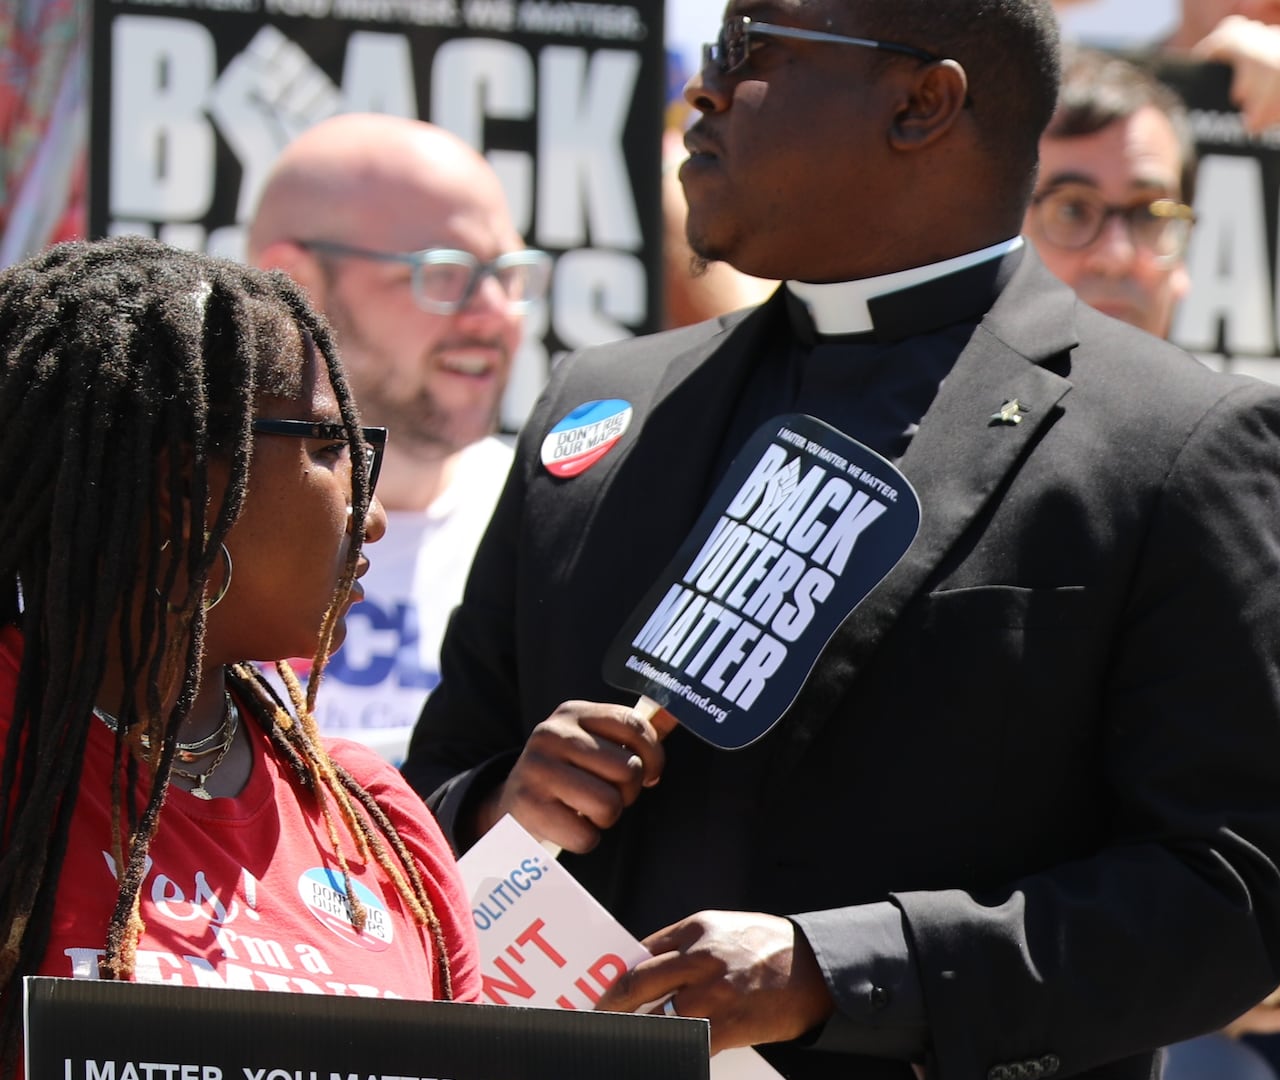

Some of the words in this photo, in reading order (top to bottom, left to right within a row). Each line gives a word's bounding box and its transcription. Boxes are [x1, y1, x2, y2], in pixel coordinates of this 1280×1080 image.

[554, 442, 583, 458] OUR
[558, 424, 599, 445] DON'T
[805, 438, 819, 455] YOU
[819, 446, 849, 470] MATTER.
[848, 463, 862, 479] WE
[860, 470, 897, 502] MATTER.
[682, 515, 835, 642] VOTERS
[632, 583, 788, 712] MATTER
[625, 654, 729, 723] BlackVotersMatterFund.org
[472, 857, 548, 930] OLITICS:
[296, 943, 332, 975] a
